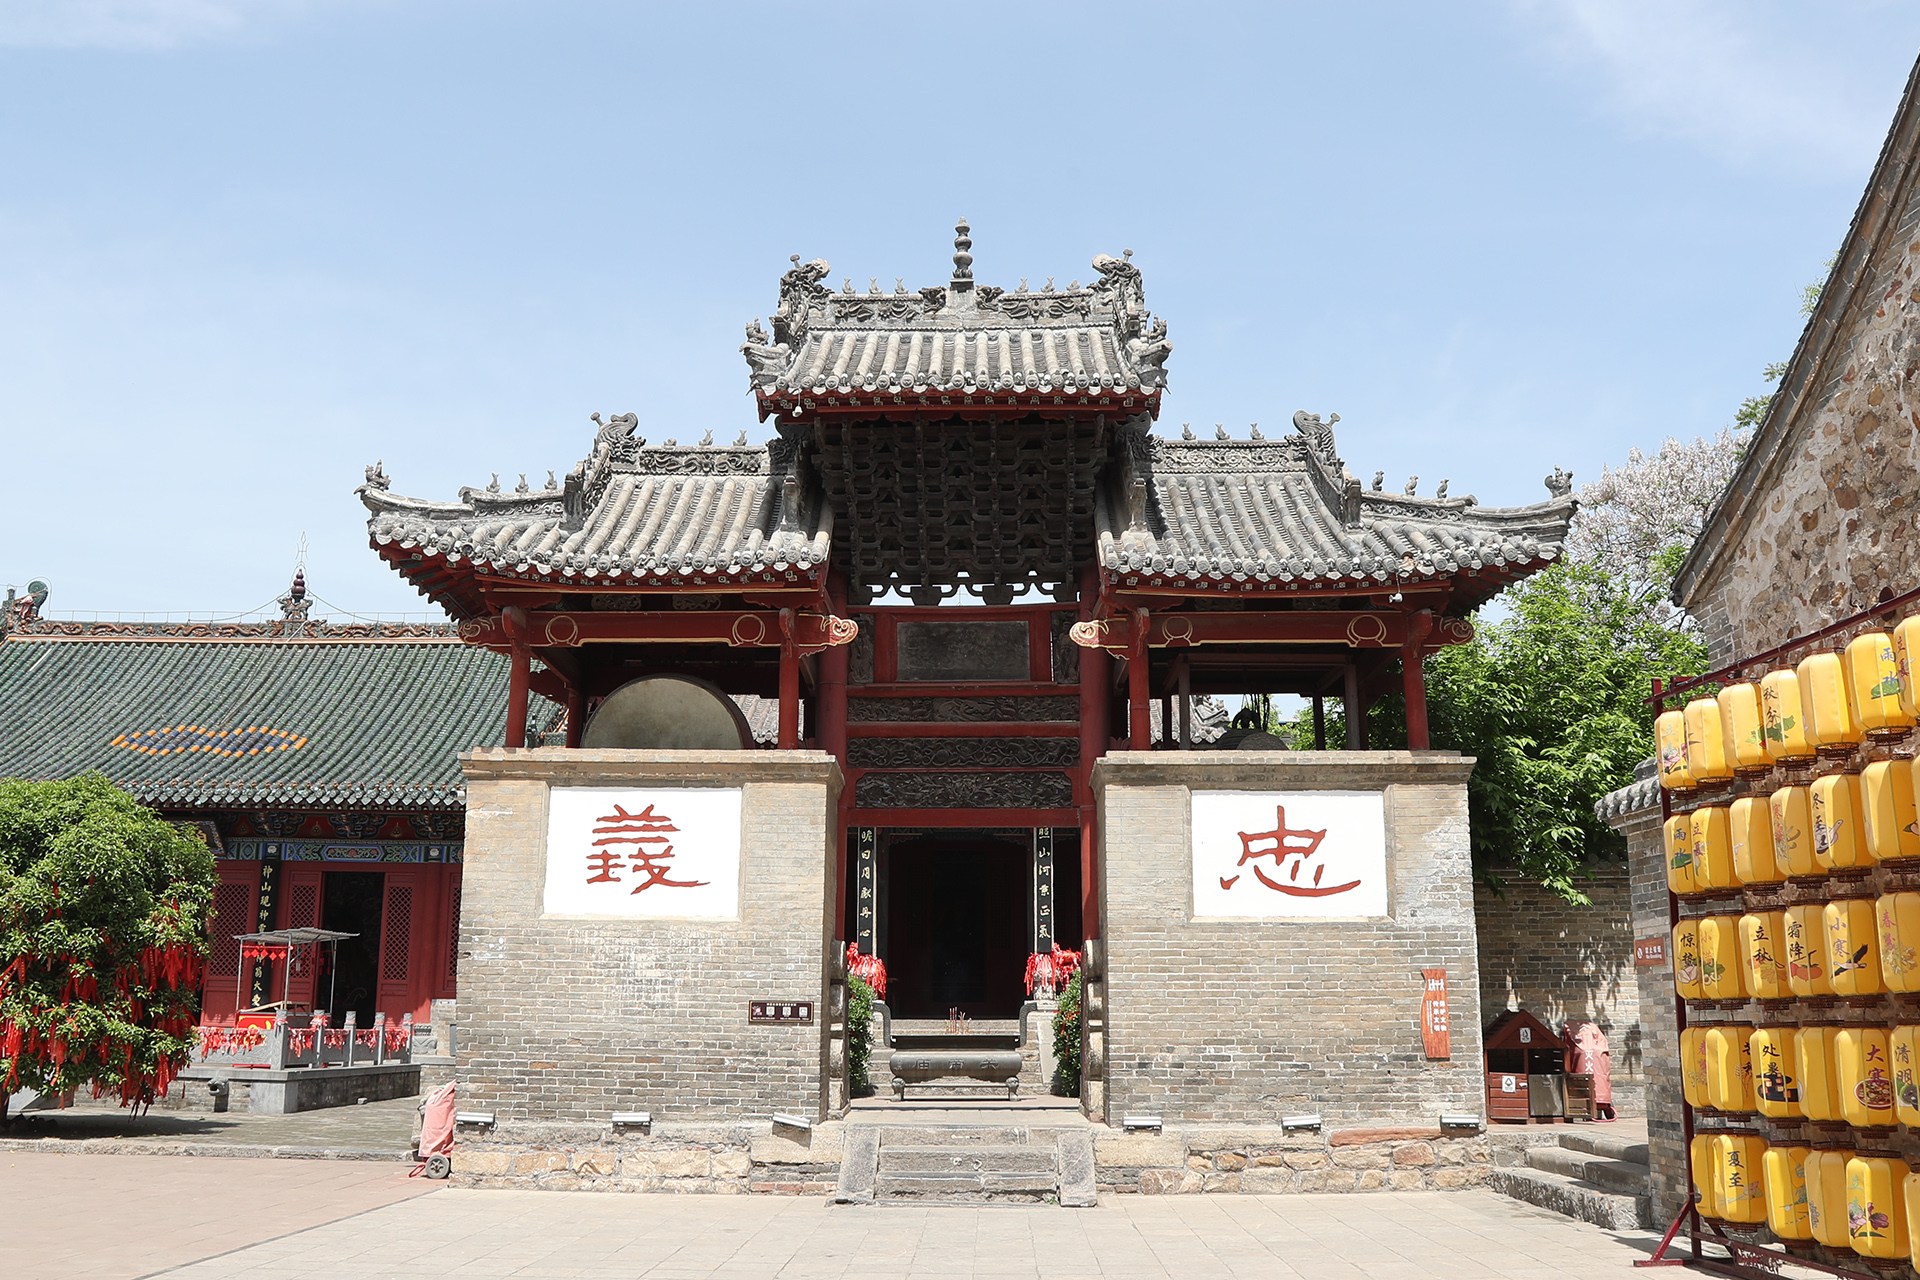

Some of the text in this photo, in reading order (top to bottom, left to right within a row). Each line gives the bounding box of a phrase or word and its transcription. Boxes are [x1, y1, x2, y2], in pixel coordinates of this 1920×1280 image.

[1880, 647, 1898, 687] 雨水
[1763, 686, 1780, 727] 秋分
[1812, 793, 1824, 832] 冬至
[1220, 805, 1362, 897] 忠
[1674, 828, 1688, 862] 雨水
[1693, 822, 1705, 857] 立夏
[1680, 932, 1696, 966] 惊蛰
[1753, 926, 1773, 961] 立秋
[1788, 921, 1804, 959] 霜降
[1830, 917, 1850, 957] 小寒
[1762, 1043, 1780, 1074] 处暑
[1866, 1044, 1886, 1086] 大寒
[1895, 1043, 1912, 1086] 清明
[1727, 1151, 1744, 1187] 夏至
